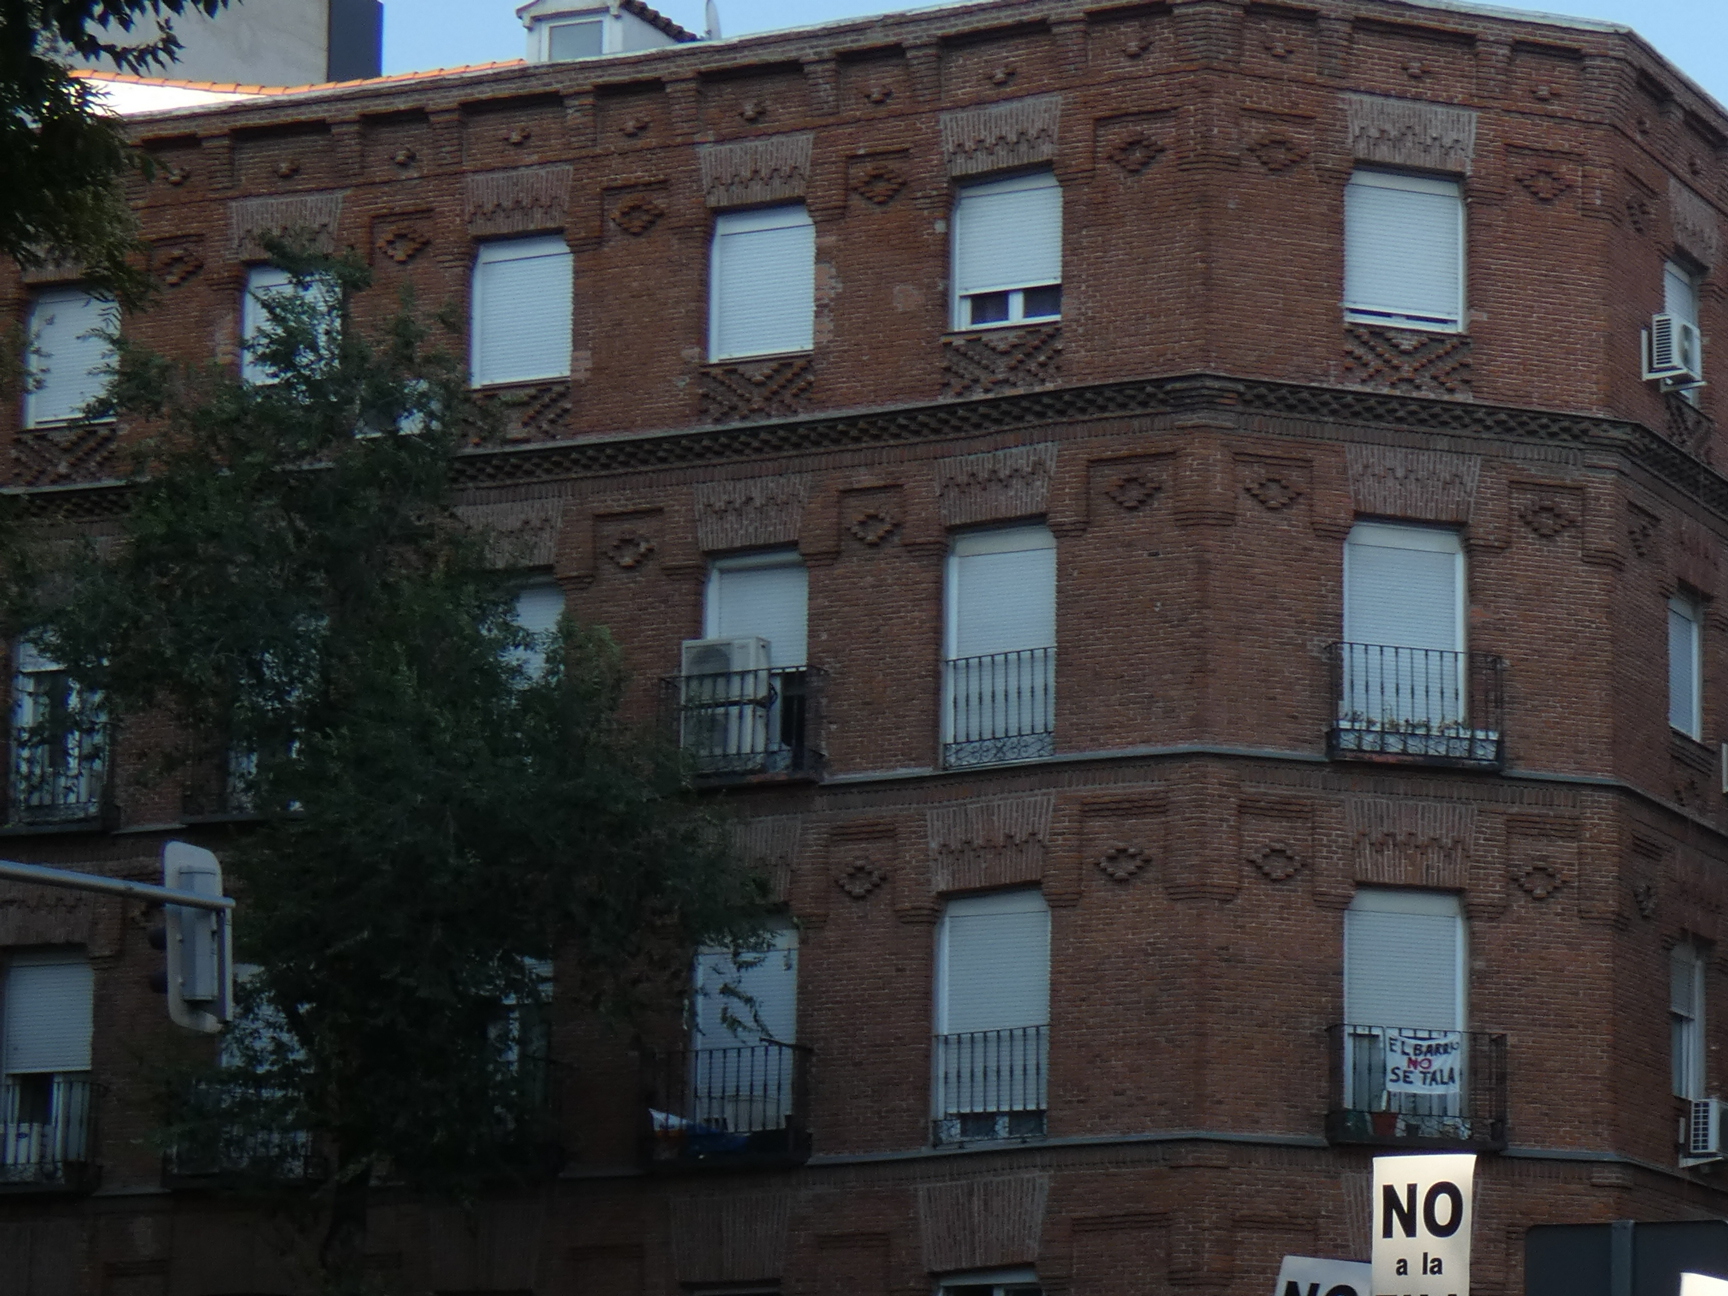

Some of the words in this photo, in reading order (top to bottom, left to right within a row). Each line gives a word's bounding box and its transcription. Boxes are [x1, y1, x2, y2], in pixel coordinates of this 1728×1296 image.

[1389, 1037, 1410, 1056] EL
[1407, 1057, 1432, 1070] NO
[1389, 1067, 1414, 1084] SE
[1419, 1067, 1456, 1086] TALA
[1382, 1181, 1463, 1239] NO
[1396, 1258, 1408, 1276] a
[1422, 1252, 1443, 1276] la
